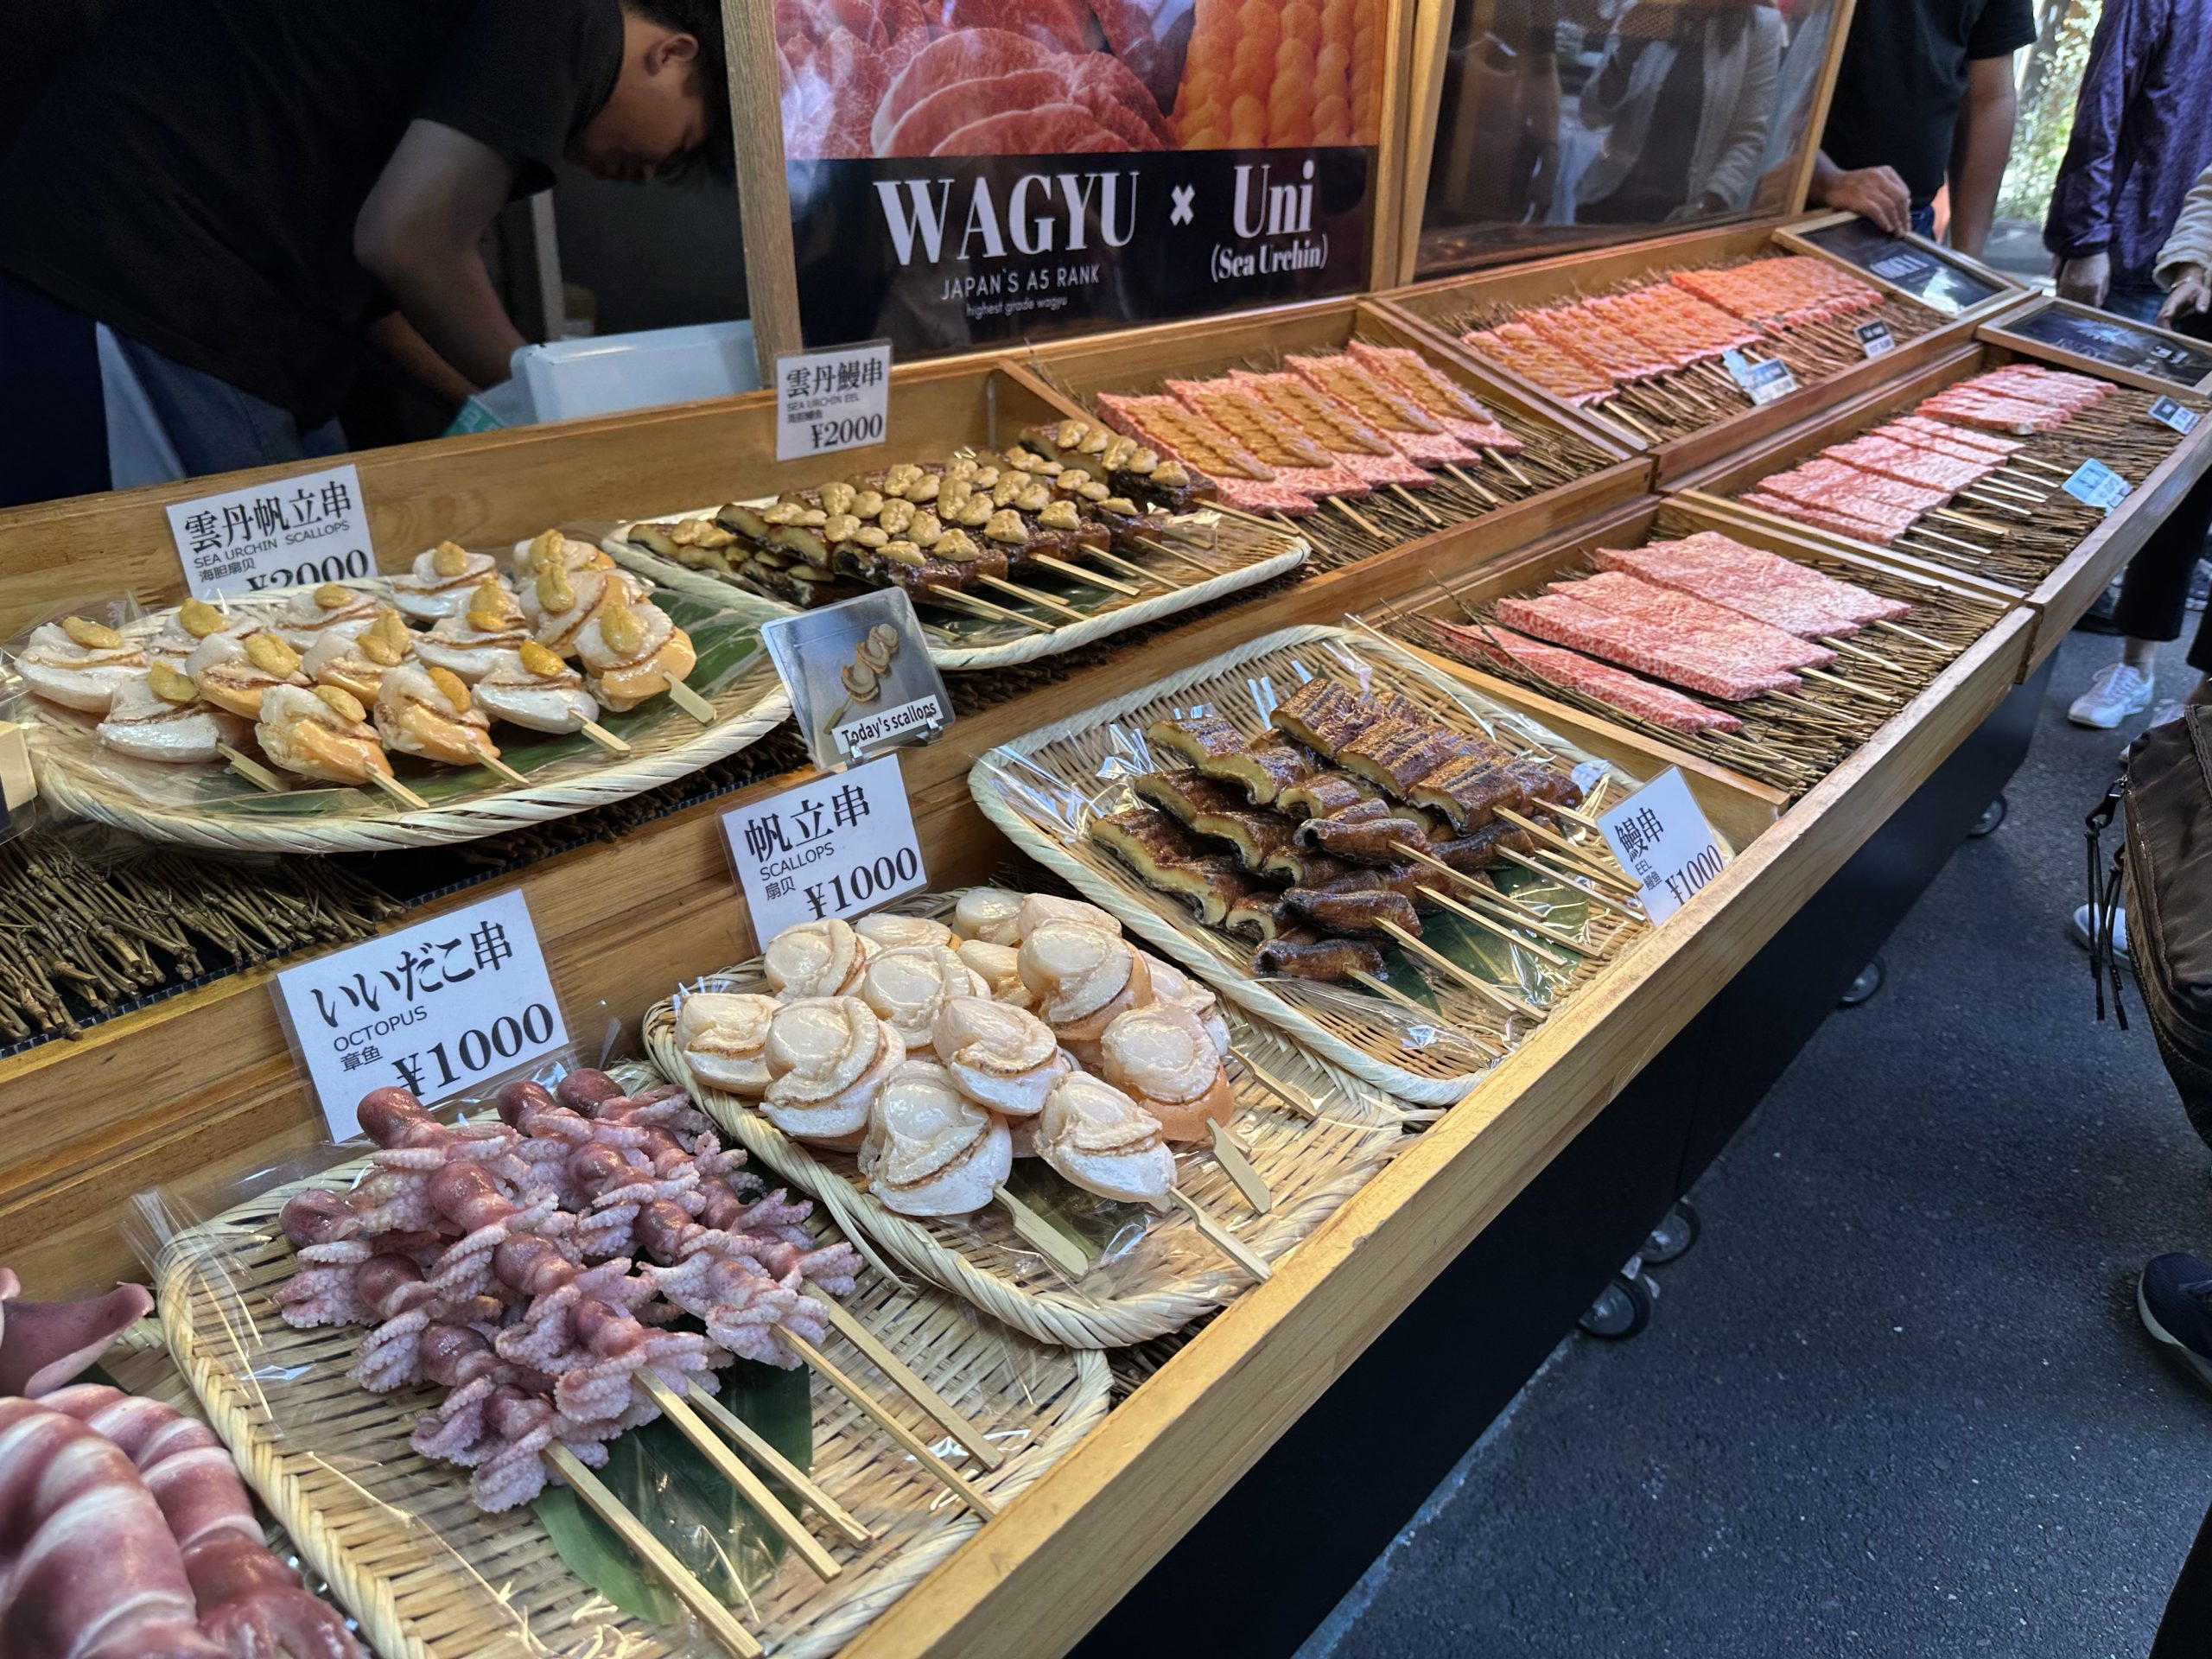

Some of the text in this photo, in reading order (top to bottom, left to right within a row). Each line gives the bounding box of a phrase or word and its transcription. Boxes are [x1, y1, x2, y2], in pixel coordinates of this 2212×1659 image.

[873, 171, 1140, 266] WAGYU
[1233, 159, 1314, 238] Uni
[1027, 269, 1050, 290] A5
[1057, 264, 1100, 287] RANK
[1211, 232, 1328, 283] (Sea Urchin)
[966, 296, 1068, 320] highest grade wagyu
[786, 358, 882, 398] 雲丹鰻串
[787, 401, 805, 412] SEA
[845, 392, 860, 404] EEL
[810, 413, 882, 449] ¥2000
[185, 480, 352, 554] 雲丹帆立串
[194, 520, 350, 569] SEA URCHIN SCALLOPS
[198, 557, 257, 583] 海胆扇贝
[842, 717, 891, 745] Today's
[744, 785, 871, 863] 帆立串
[1614, 807, 1664, 862] 鰻串
[760, 842, 835, 881] SCALLOPS
[1635, 859, 1652, 875] EEL
[1664, 845, 1724, 906] ¥1000
[765, 875, 797, 901] 扇贝
[803, 847, 918, 921] ¥1000
[310, 920, 513, 1028] いいだこ串
[334, 1005, 428, 1052] OCTOPUS
[391, 1003, 554, 1097] ¥1000
[340, 1045, 383, 1072] 章鱼
